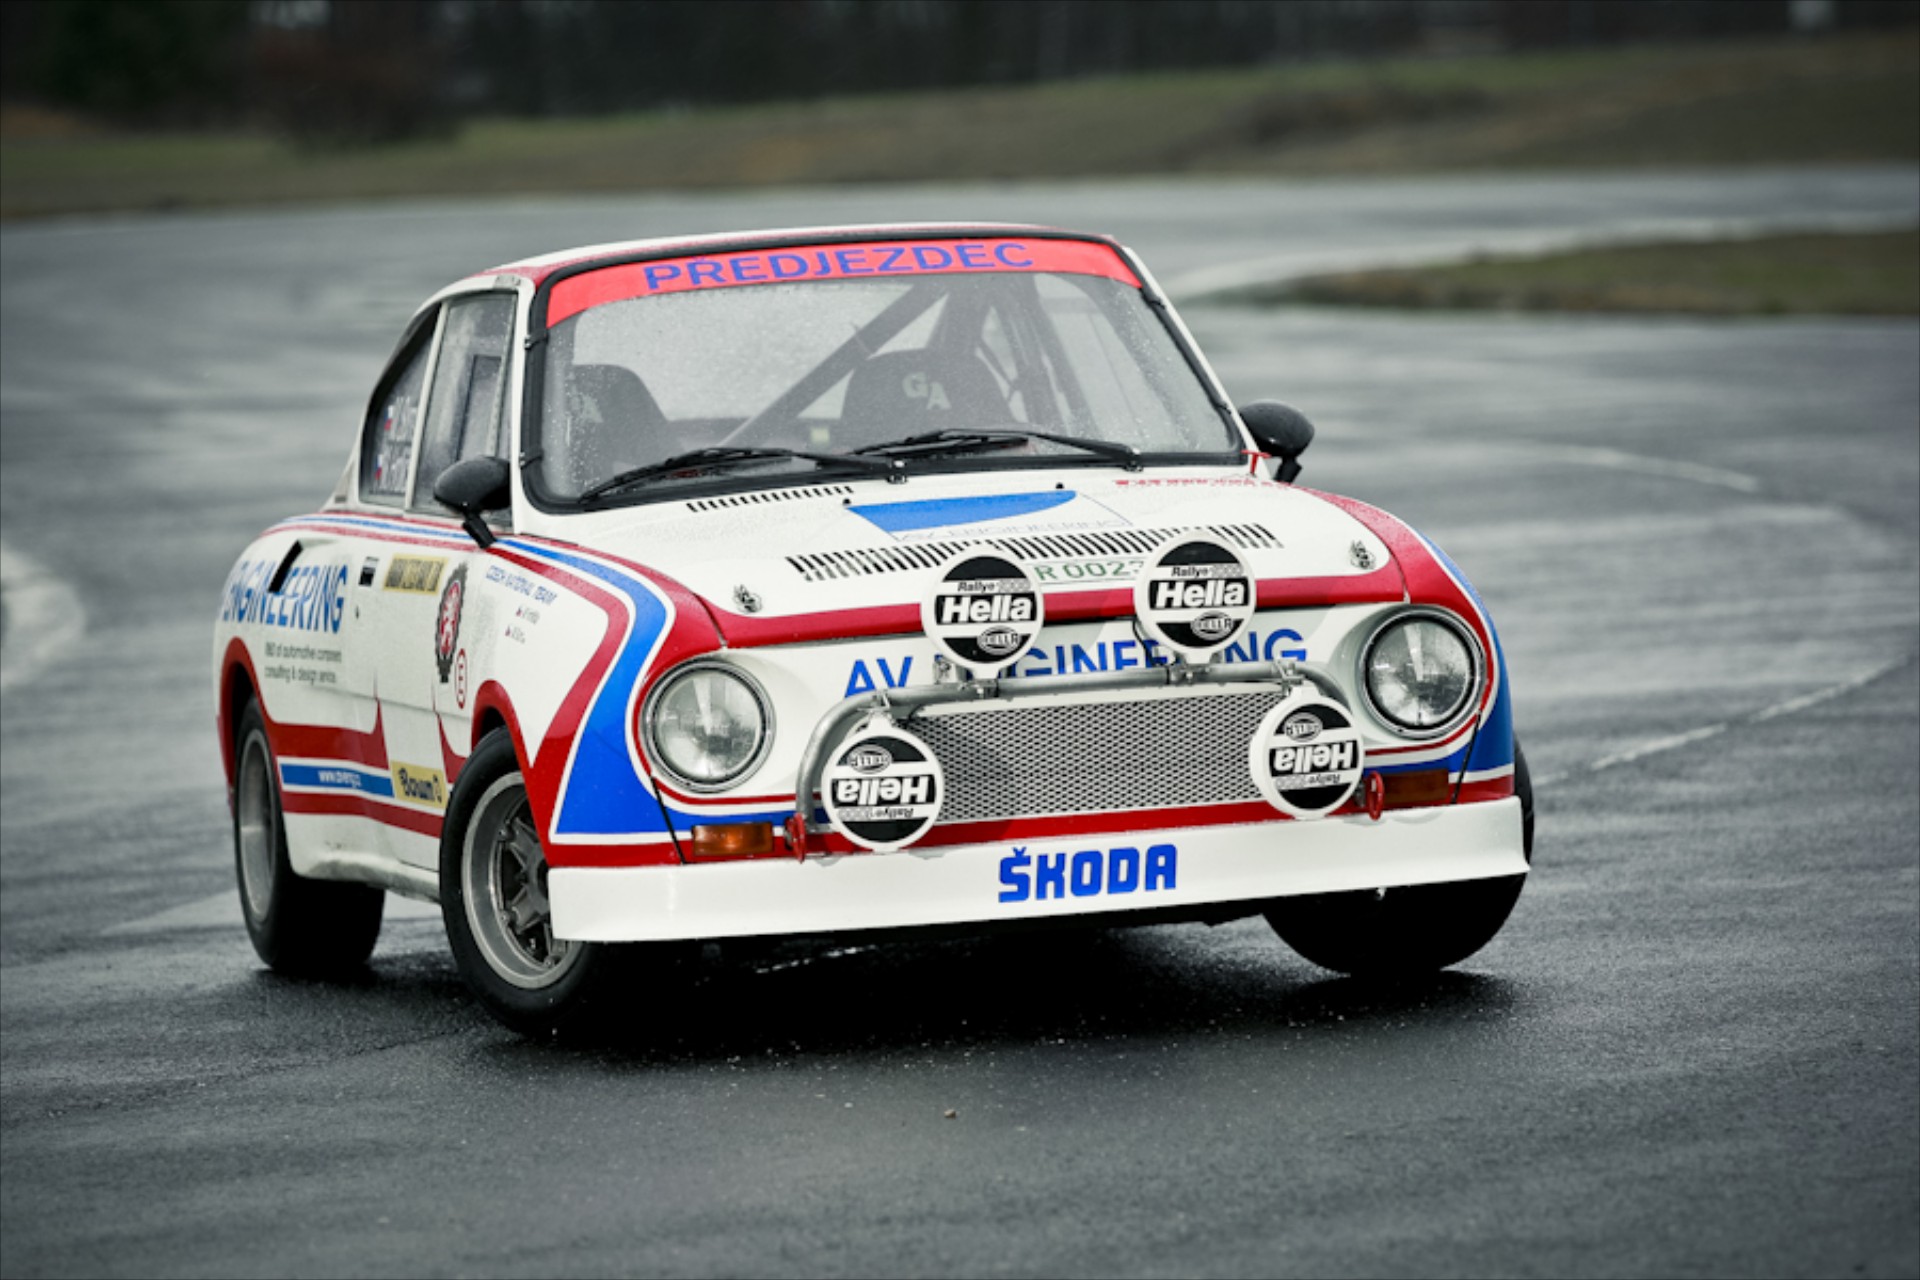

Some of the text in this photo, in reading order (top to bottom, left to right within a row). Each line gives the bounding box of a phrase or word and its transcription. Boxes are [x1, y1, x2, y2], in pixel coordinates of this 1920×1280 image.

[957, 581, 995, 594] Rallye
[1171, 566, 1208, 579] Rallye
[941, 594, 1032, 623] Hella
[1155, 579, 1245, 609] Hella
[844, 656, 913, 698] AV
[1274, 742, 1353, 773] Hella
[837, 775, 929, 806] Hella
[875, 807, 914, 819] Rallye
[998, 843, 1177, 903] ŠKODA
